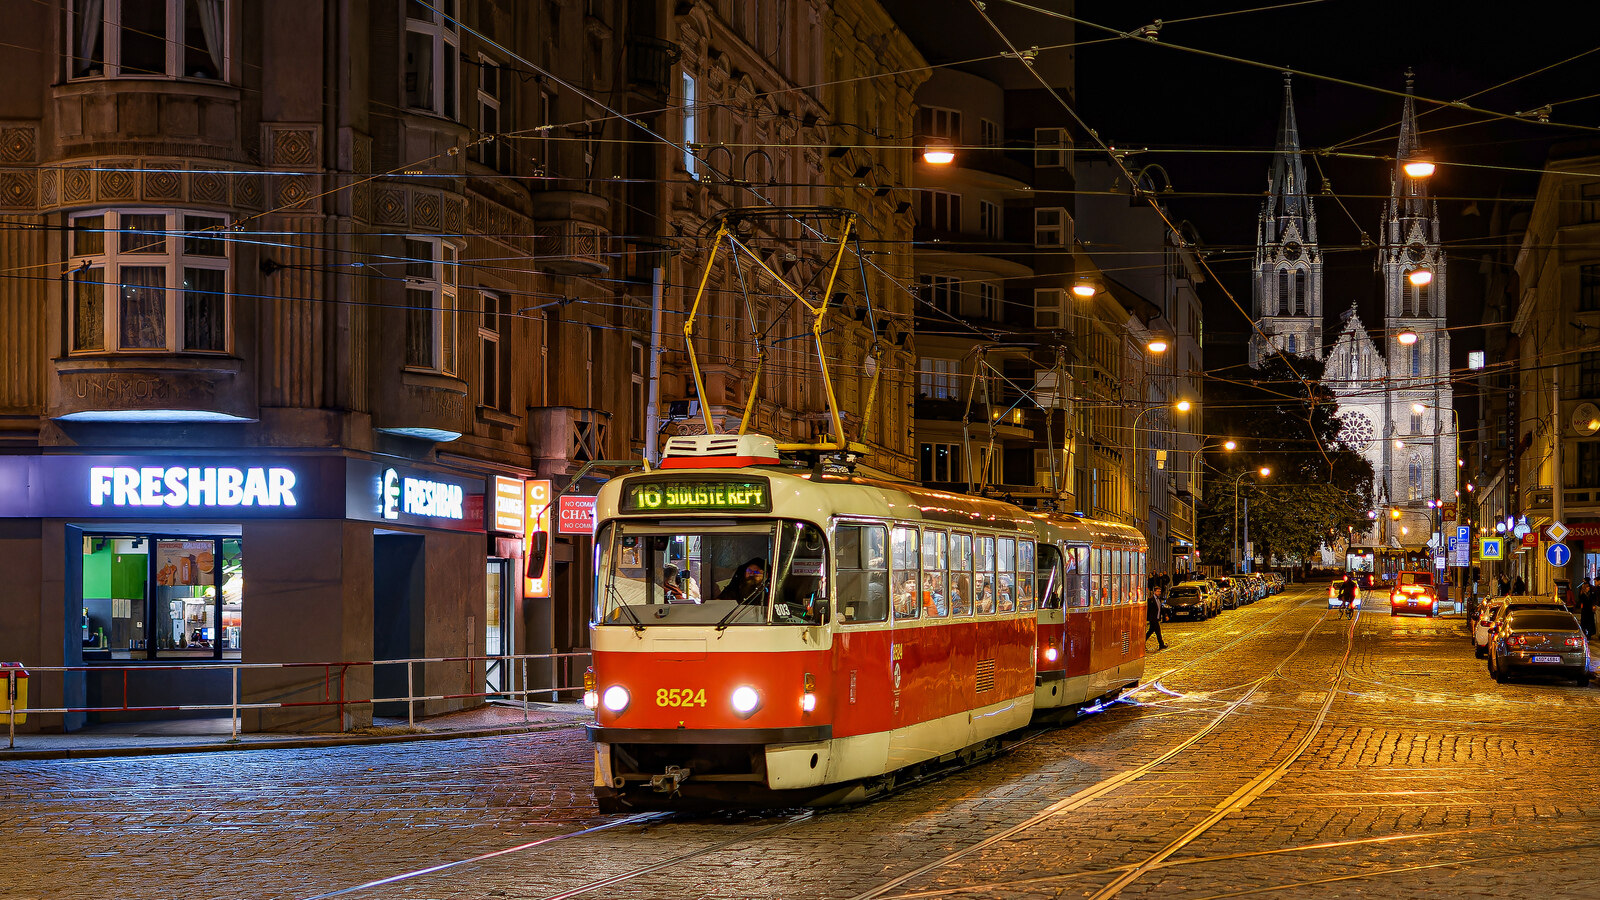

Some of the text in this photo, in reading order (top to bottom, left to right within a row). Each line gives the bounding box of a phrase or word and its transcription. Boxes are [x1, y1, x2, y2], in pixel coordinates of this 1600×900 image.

[90, 466, 297, 506] FRESHBAR
[631, 484, 662, 508] 16
[404, 477, 463, 520] FRESHBAR
[529, 485, 546, 593] CHAE
[1459, 528, 1467, 539] P
[774, 603, 791, 616] 803
[655, 688, 707, 707] 8524
